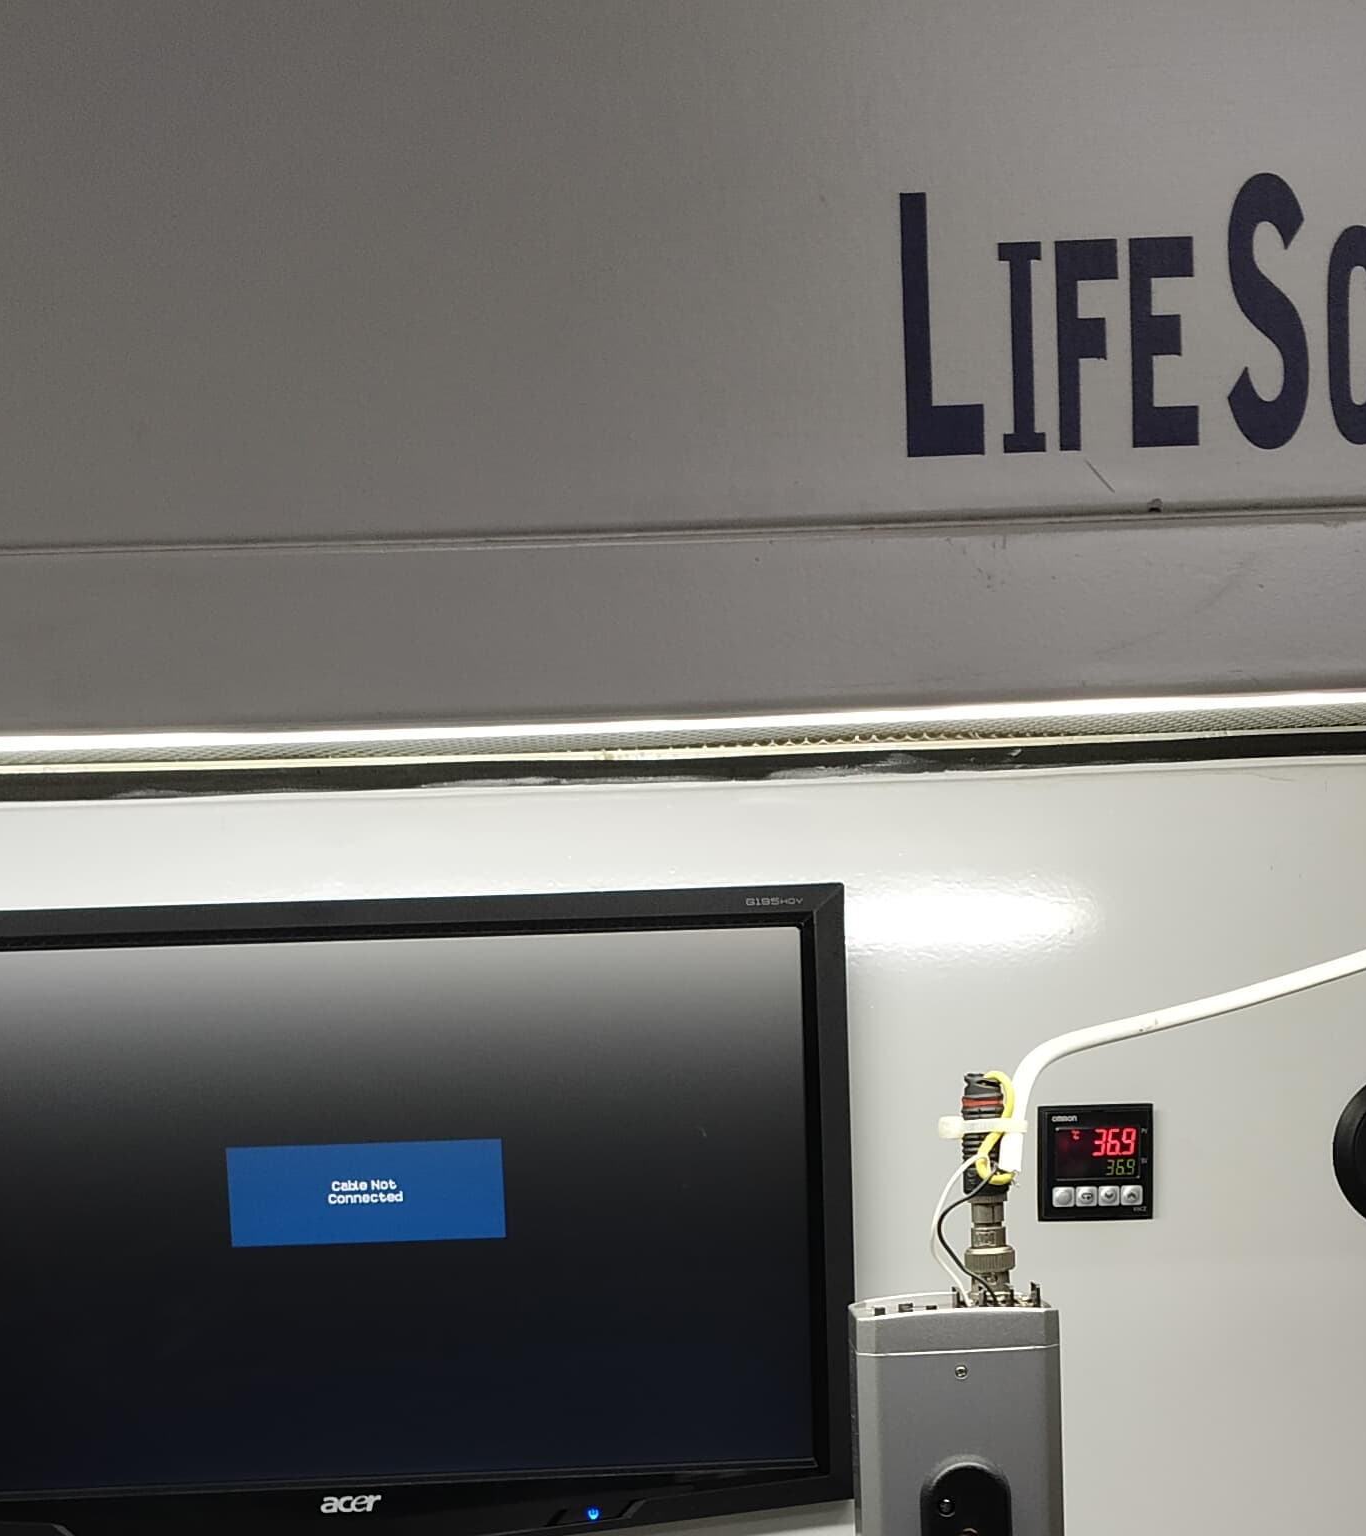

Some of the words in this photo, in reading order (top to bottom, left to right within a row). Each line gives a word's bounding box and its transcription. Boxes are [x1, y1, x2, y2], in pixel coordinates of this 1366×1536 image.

[899, 191, 1200, 457] LIFE
[1092, 1128, 1136, 1156] 36.9
[1105, 1158, 1136, 1176] 36.9
[331, 1180, 368, 1192] Cable
[370, 1179, 397, 1191] Not
[327, 1190, 404, 1205] Connected
[320, 1494, 382, 1514] acer
